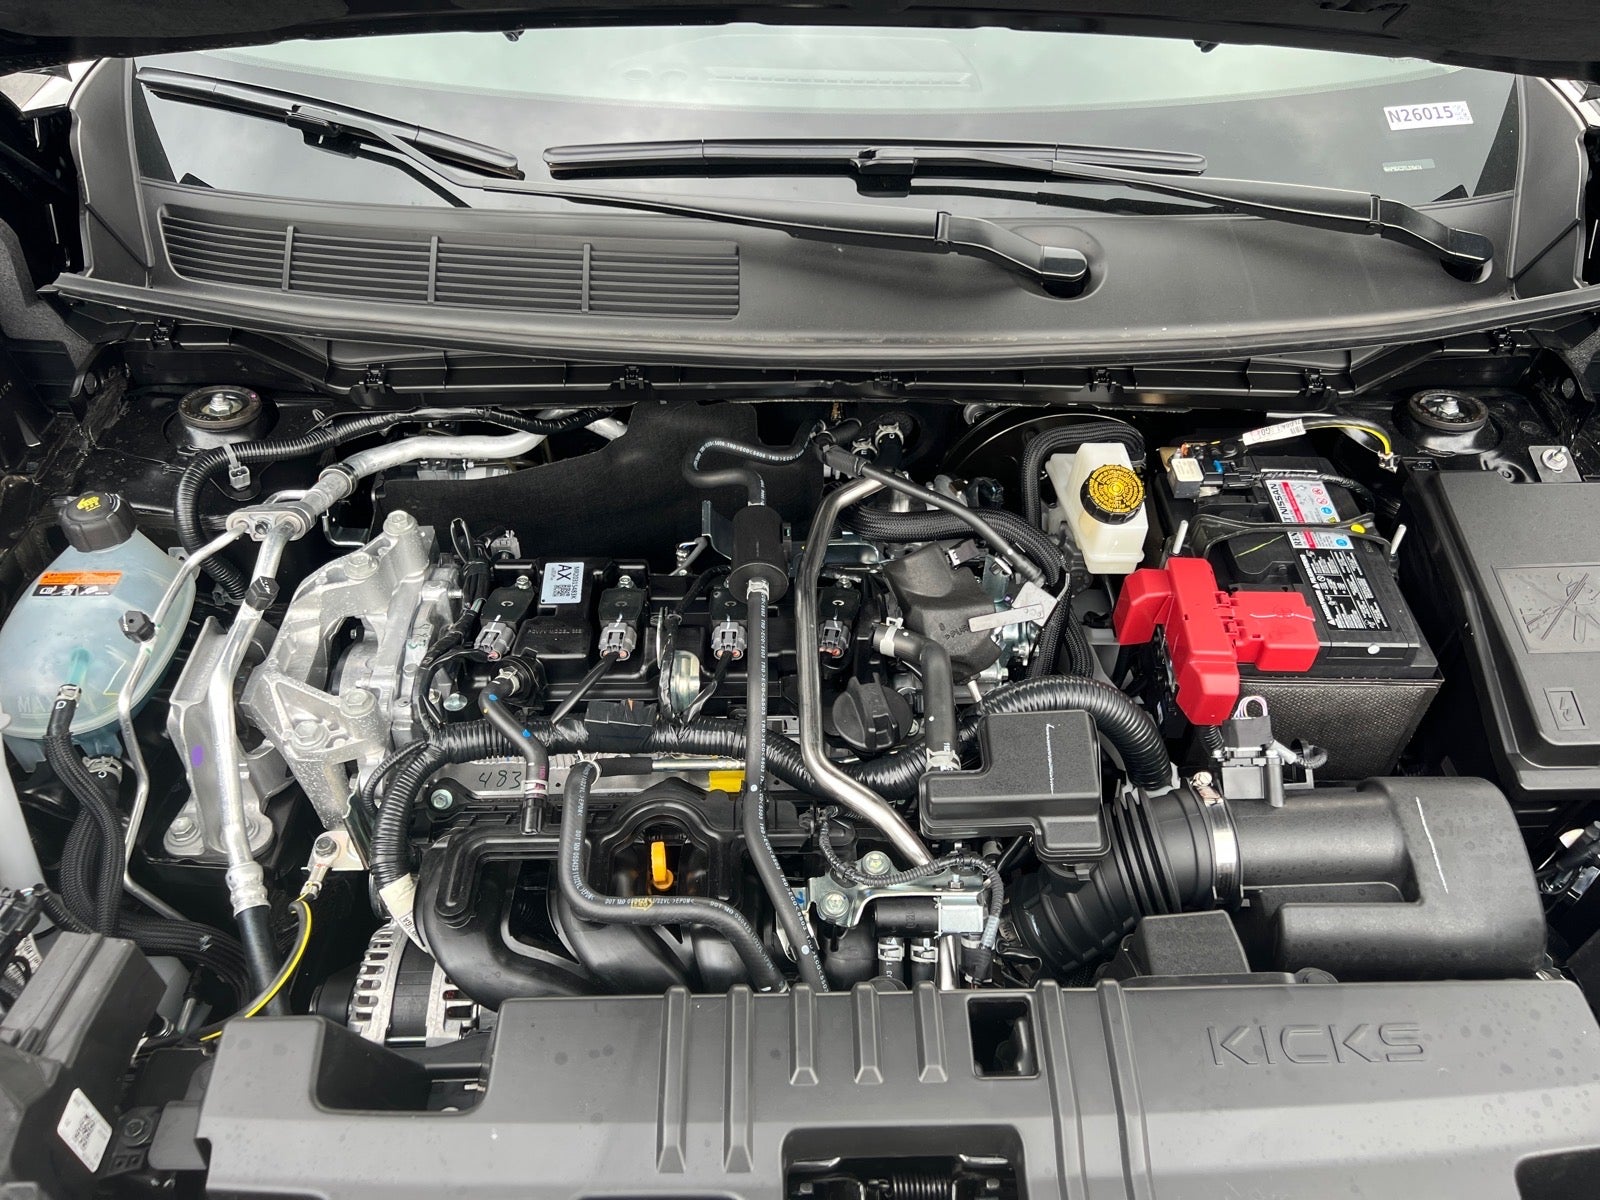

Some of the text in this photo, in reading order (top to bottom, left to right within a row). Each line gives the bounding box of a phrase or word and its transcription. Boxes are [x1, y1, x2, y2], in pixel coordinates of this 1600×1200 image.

[1387, 105, 1454, 123] N26015
[1268, 483, 1288, 518] NISSAN
[556, 564, 571, 581] AX
[478, 769, 522, 790] 483
[1206, 1022, 1426, 1066] KICKS
